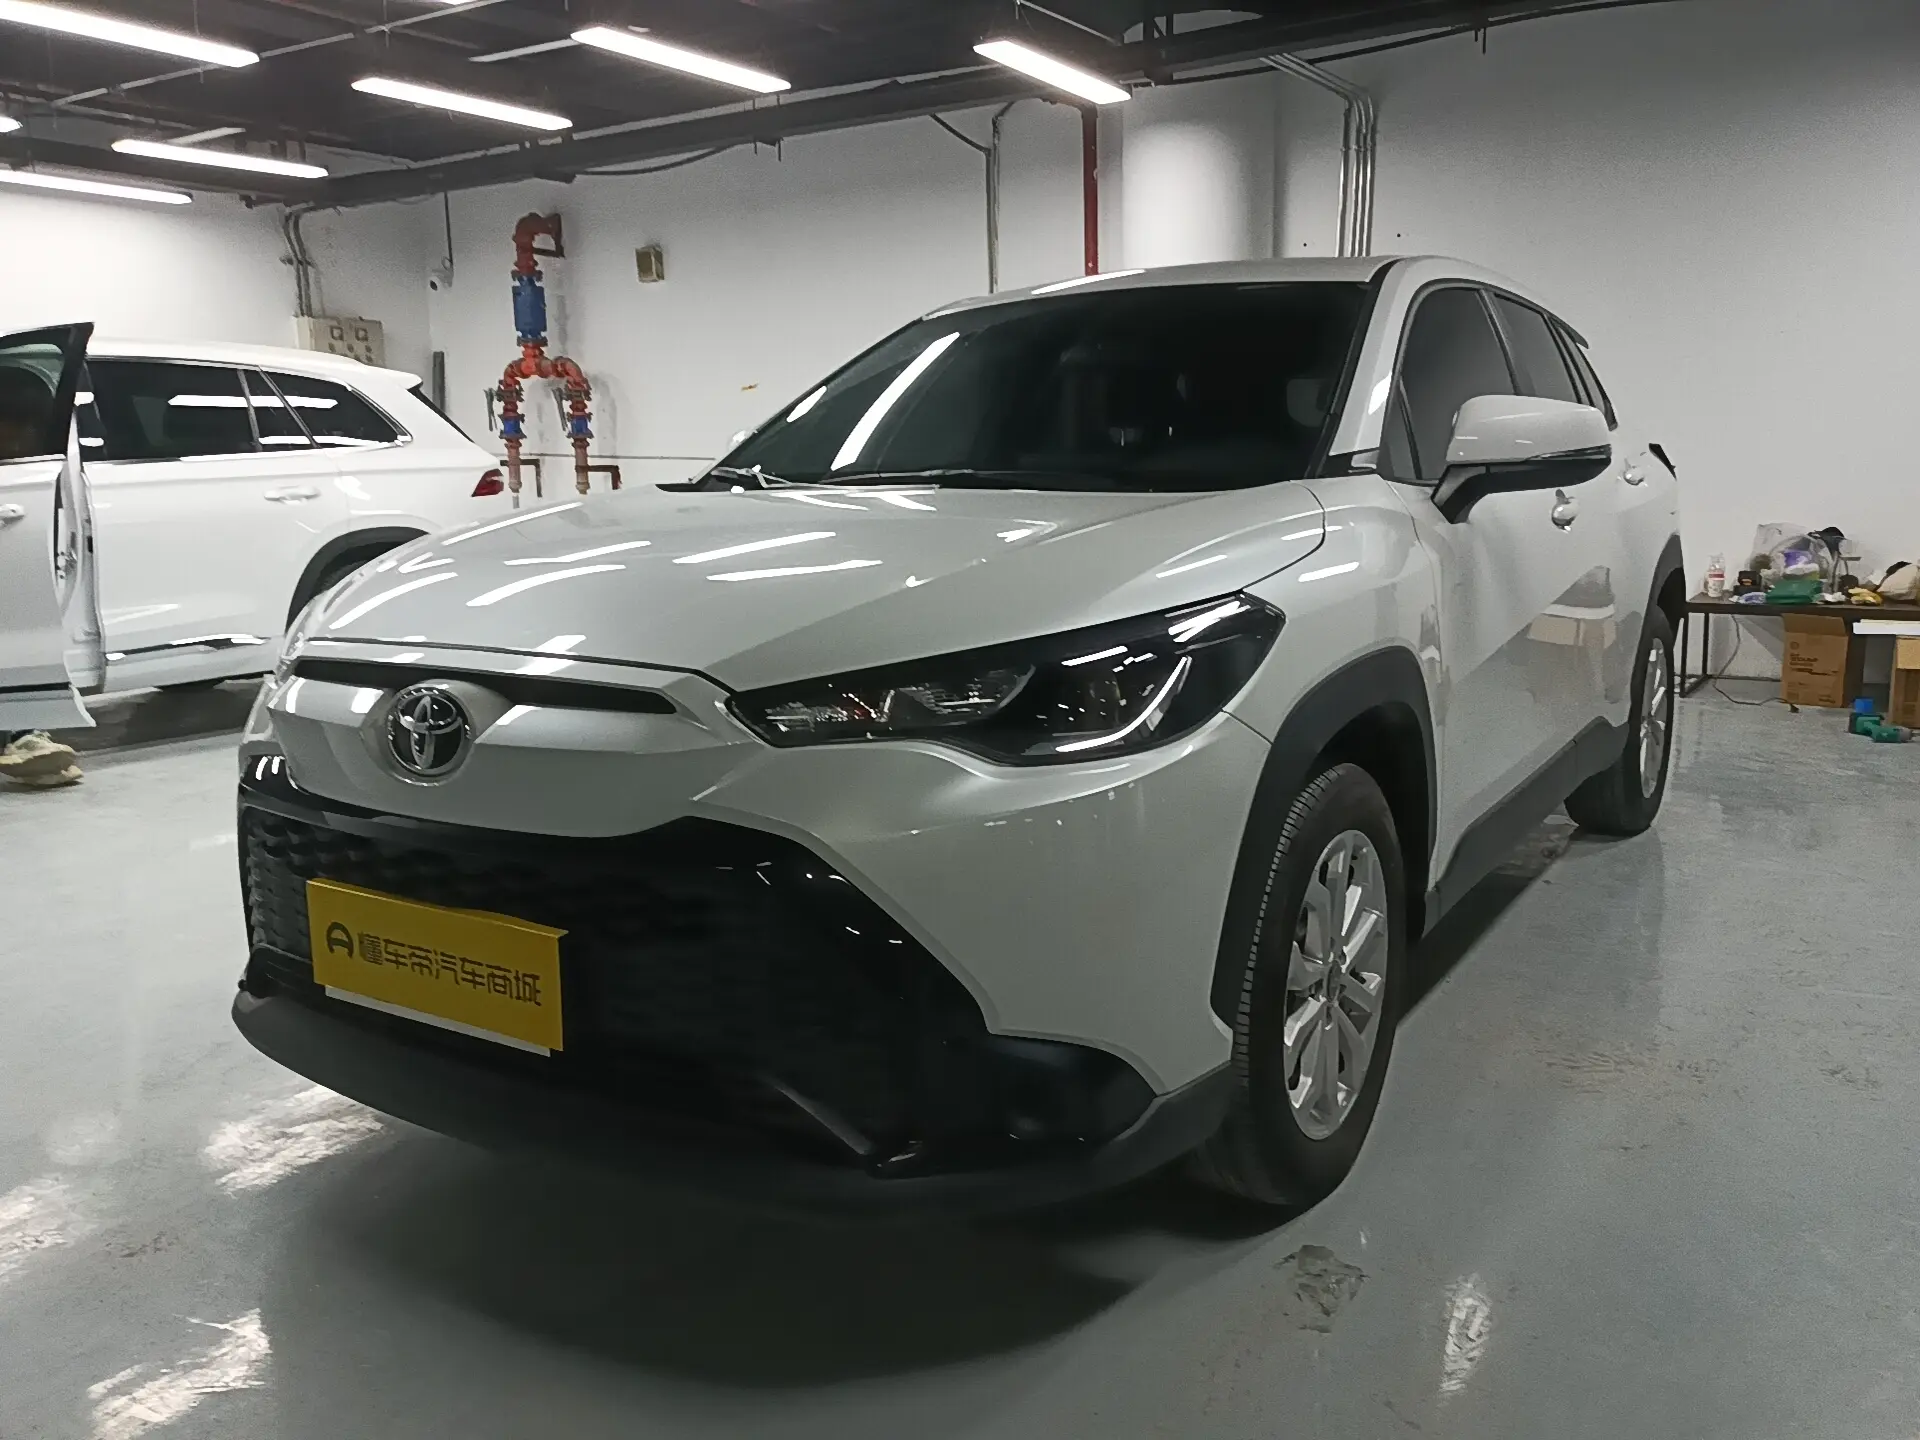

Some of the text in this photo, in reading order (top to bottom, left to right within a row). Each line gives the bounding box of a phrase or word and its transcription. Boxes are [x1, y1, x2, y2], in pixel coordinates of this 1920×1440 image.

[357, 931, 542, 1006] 懂车帝汽车商城
